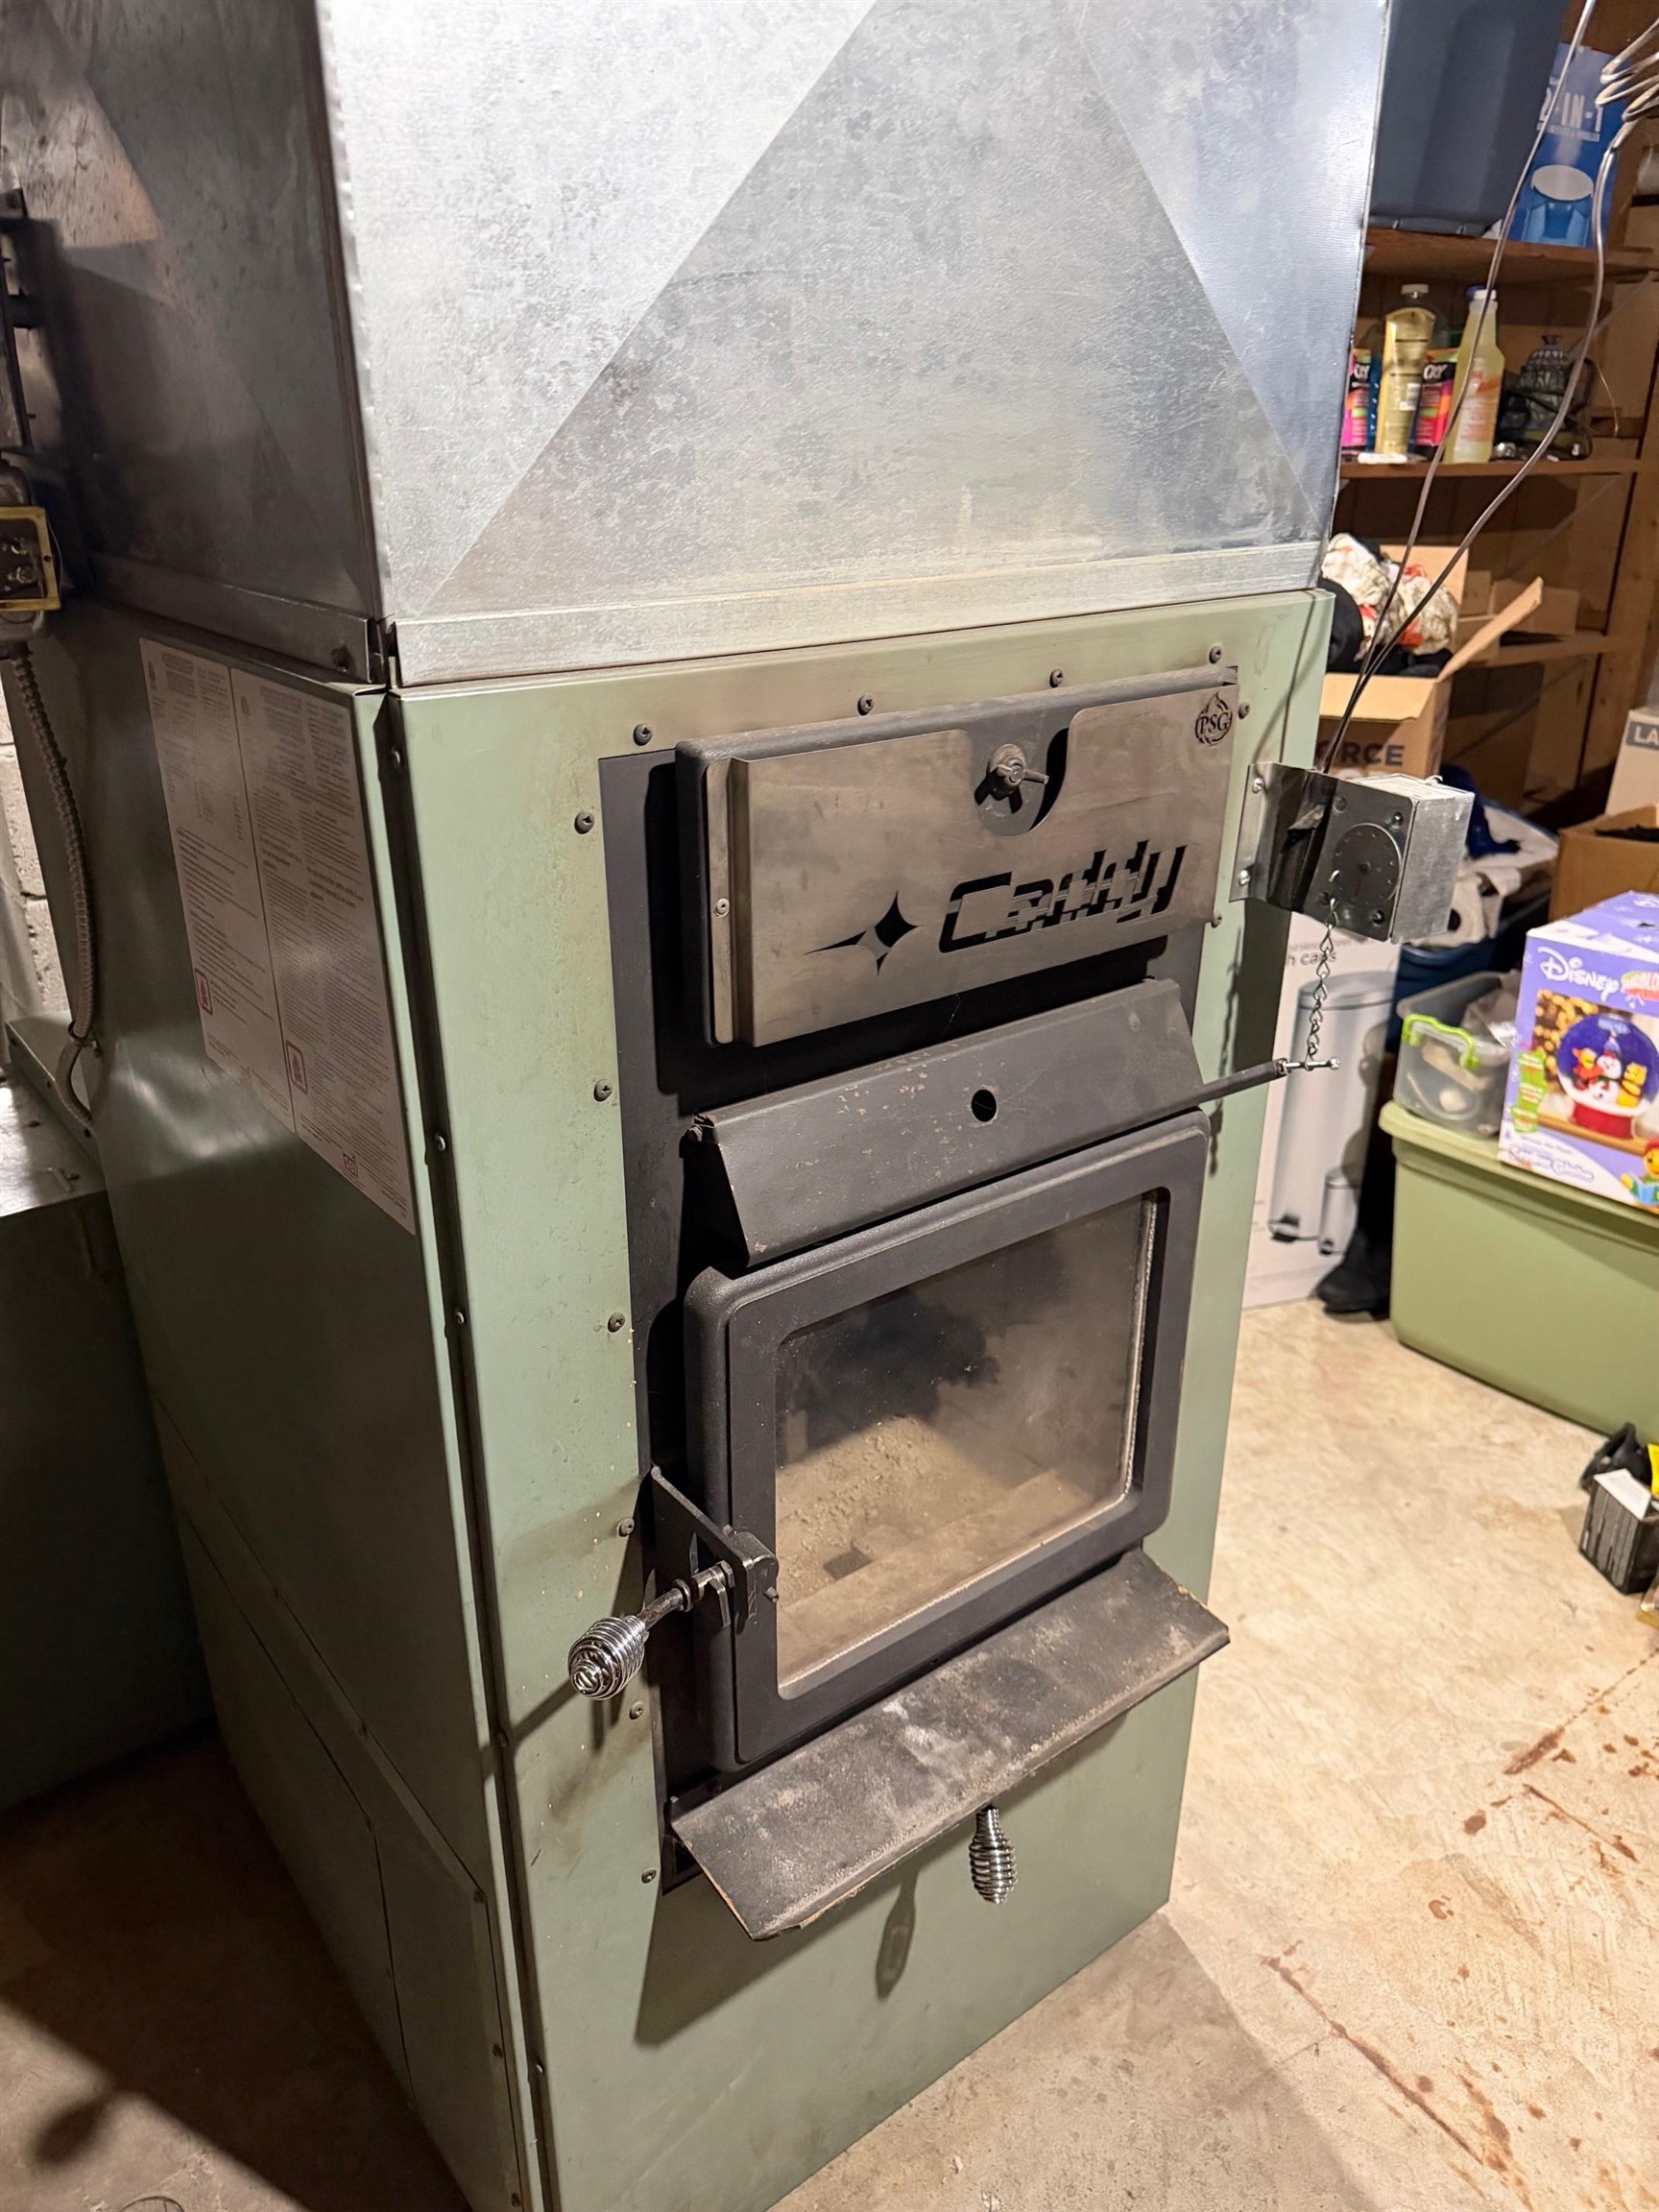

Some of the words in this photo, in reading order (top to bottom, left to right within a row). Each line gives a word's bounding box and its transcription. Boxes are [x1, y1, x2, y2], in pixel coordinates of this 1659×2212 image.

[1200, 711, 1229, 733] PSG
[939, 839, 1188, 953] Caddy
[1537, 946, 1620, 1003] Disney
